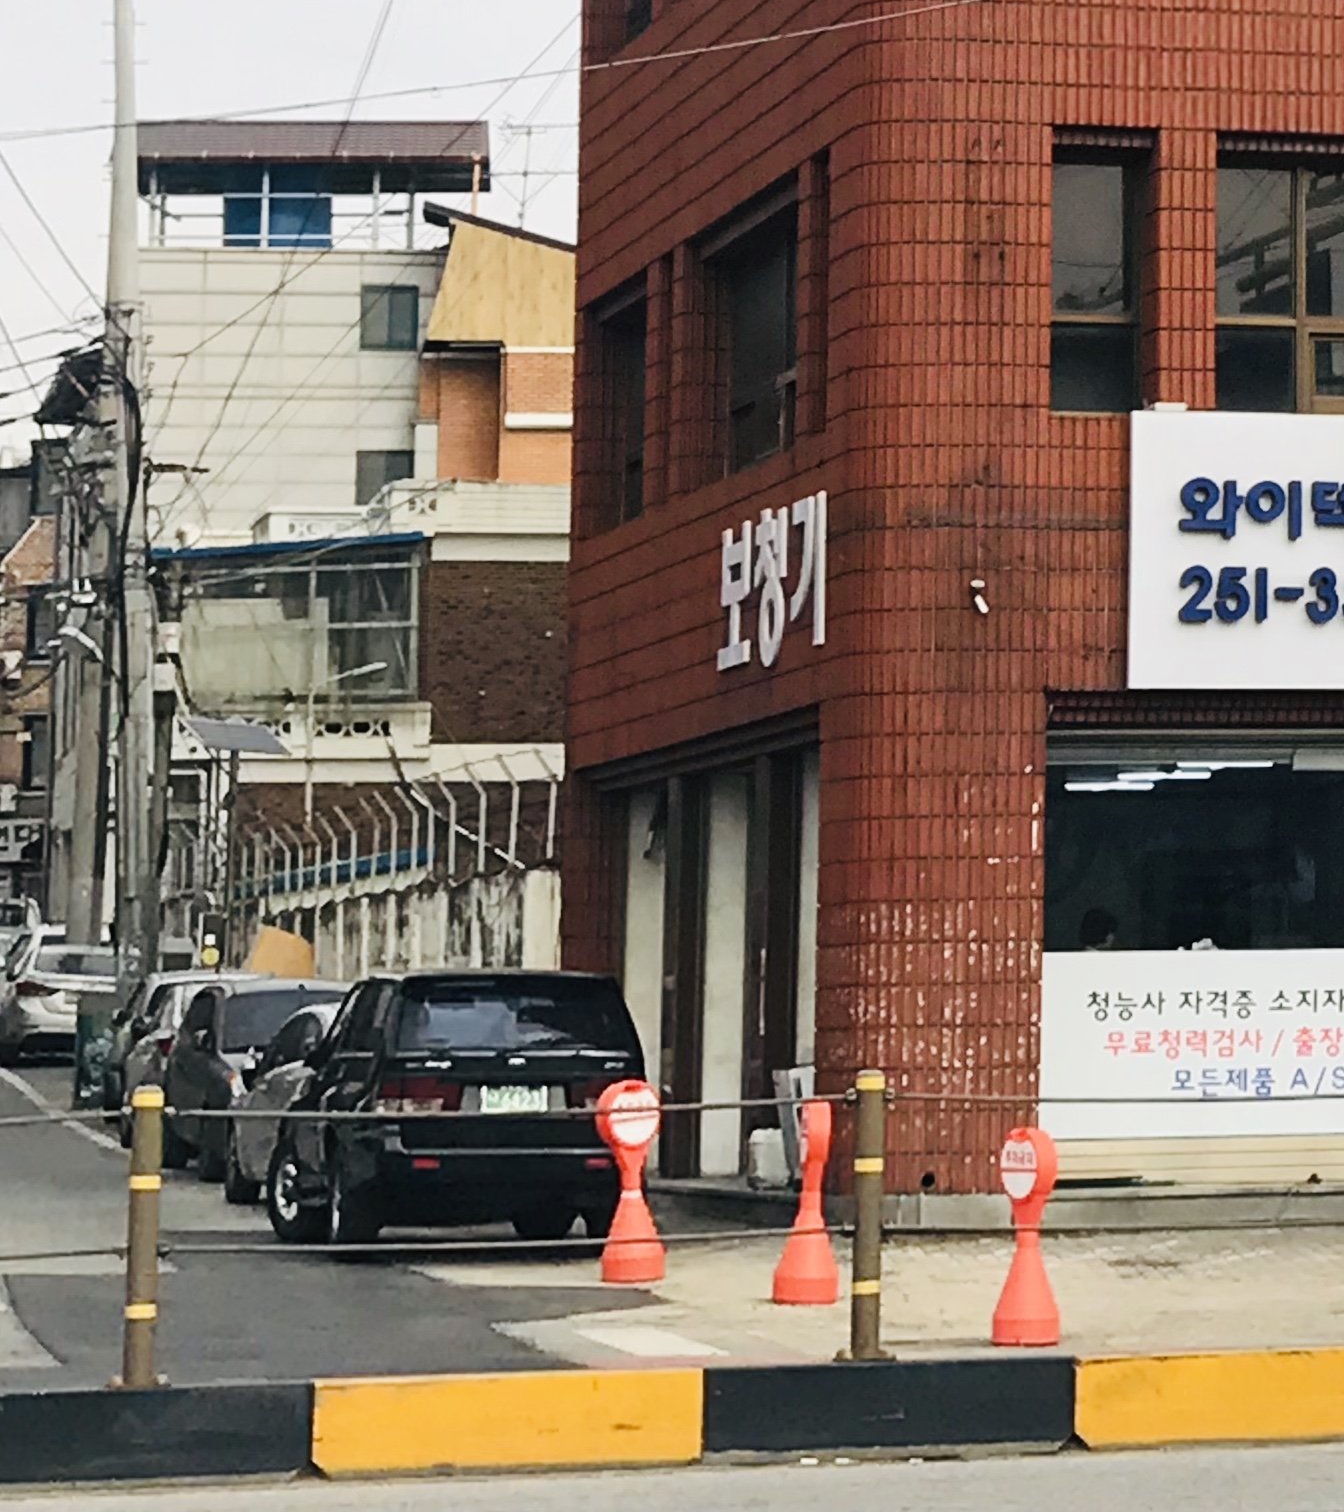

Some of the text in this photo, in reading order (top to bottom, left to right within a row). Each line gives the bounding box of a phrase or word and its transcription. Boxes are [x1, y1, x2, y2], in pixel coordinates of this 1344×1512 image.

[716, 489, 828, 672] 보청기
[1086, 989, 1166, 1021] 청능사
[1178, 989, 1257, 1020] 자격증
[1103, 1028, 1264, 1060] 무료청력검사
[1291, 1026, 1344, 1059] 출장
[1170, 1065, 1276, 1097] 모든제품
